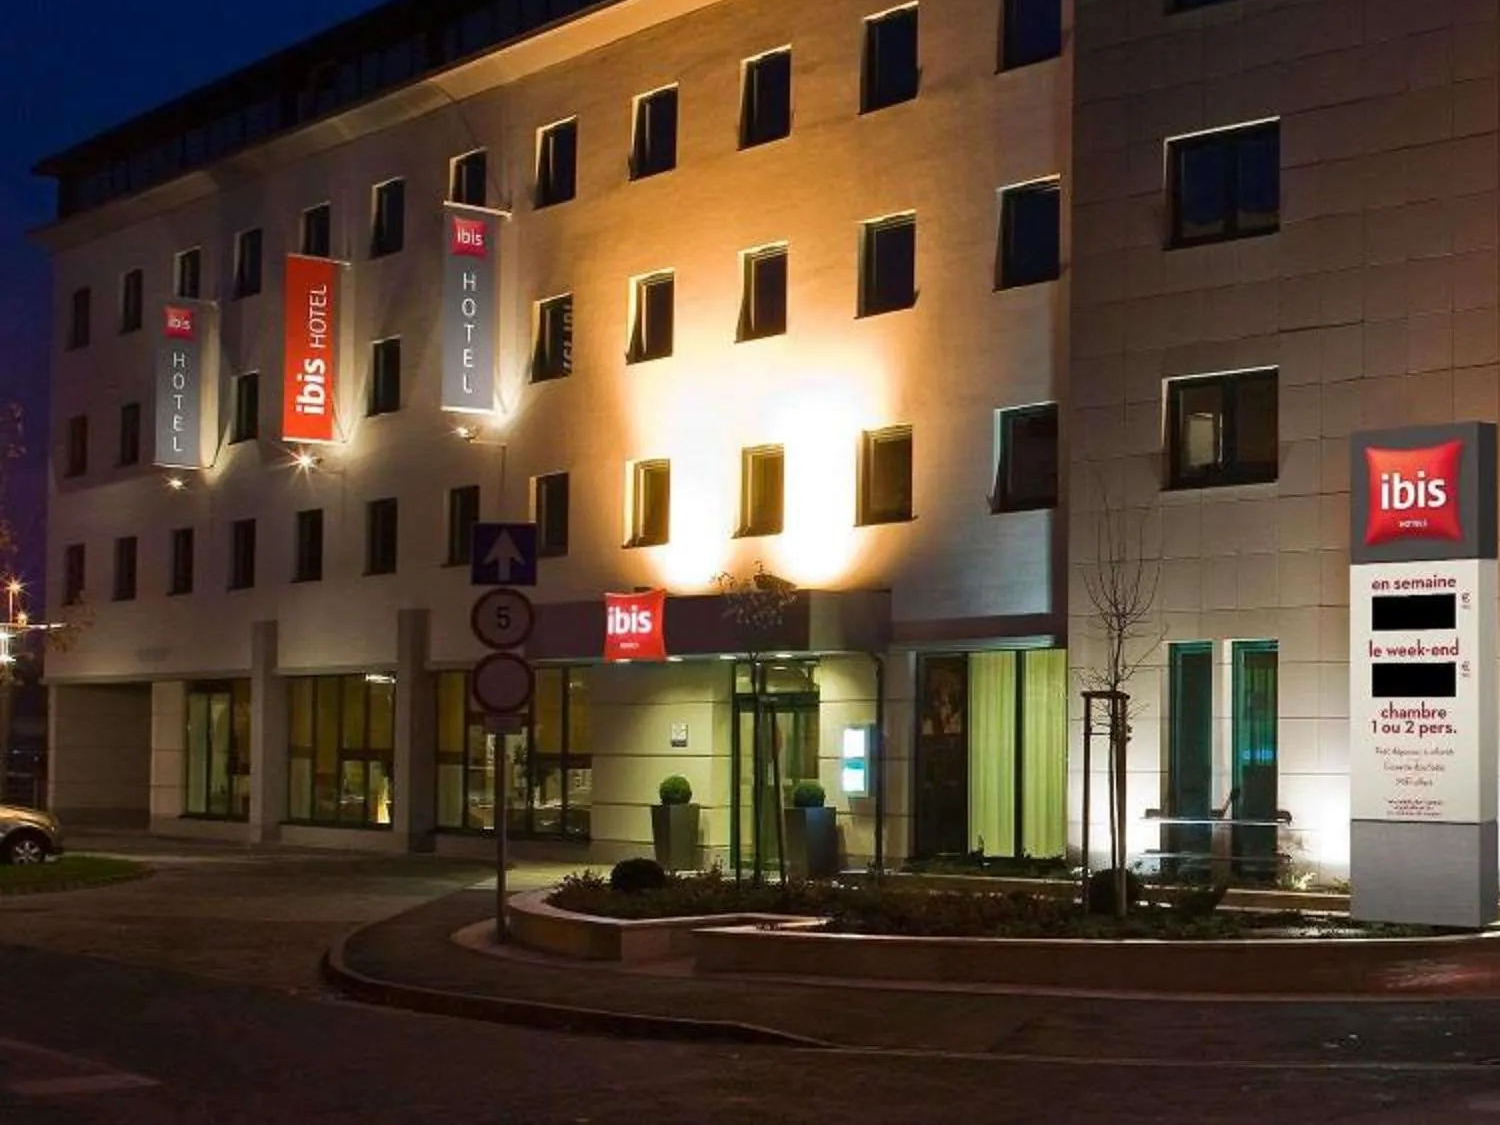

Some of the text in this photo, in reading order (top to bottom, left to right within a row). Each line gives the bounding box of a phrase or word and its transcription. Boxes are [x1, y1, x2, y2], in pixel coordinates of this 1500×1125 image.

[457, 227, 484, 247] ibis
[461, 272, 477, 395] HOTEL
[295, 283, 328, 416] ibis HOTEL
[172, 352, 186, 453] HOTEL
[1381, 470, 1447, 510] ibis
[1371, 574, 1457, 591] en semaine
[496, 605, 511, 631] 5
[607, 604, 653, 635] ibis
[1369, 636, 1460, 658] le week-end
[1381, 700, 1447, 719] chambre
[1371, 720, 1458, 739] 1 ou 2 pers.
